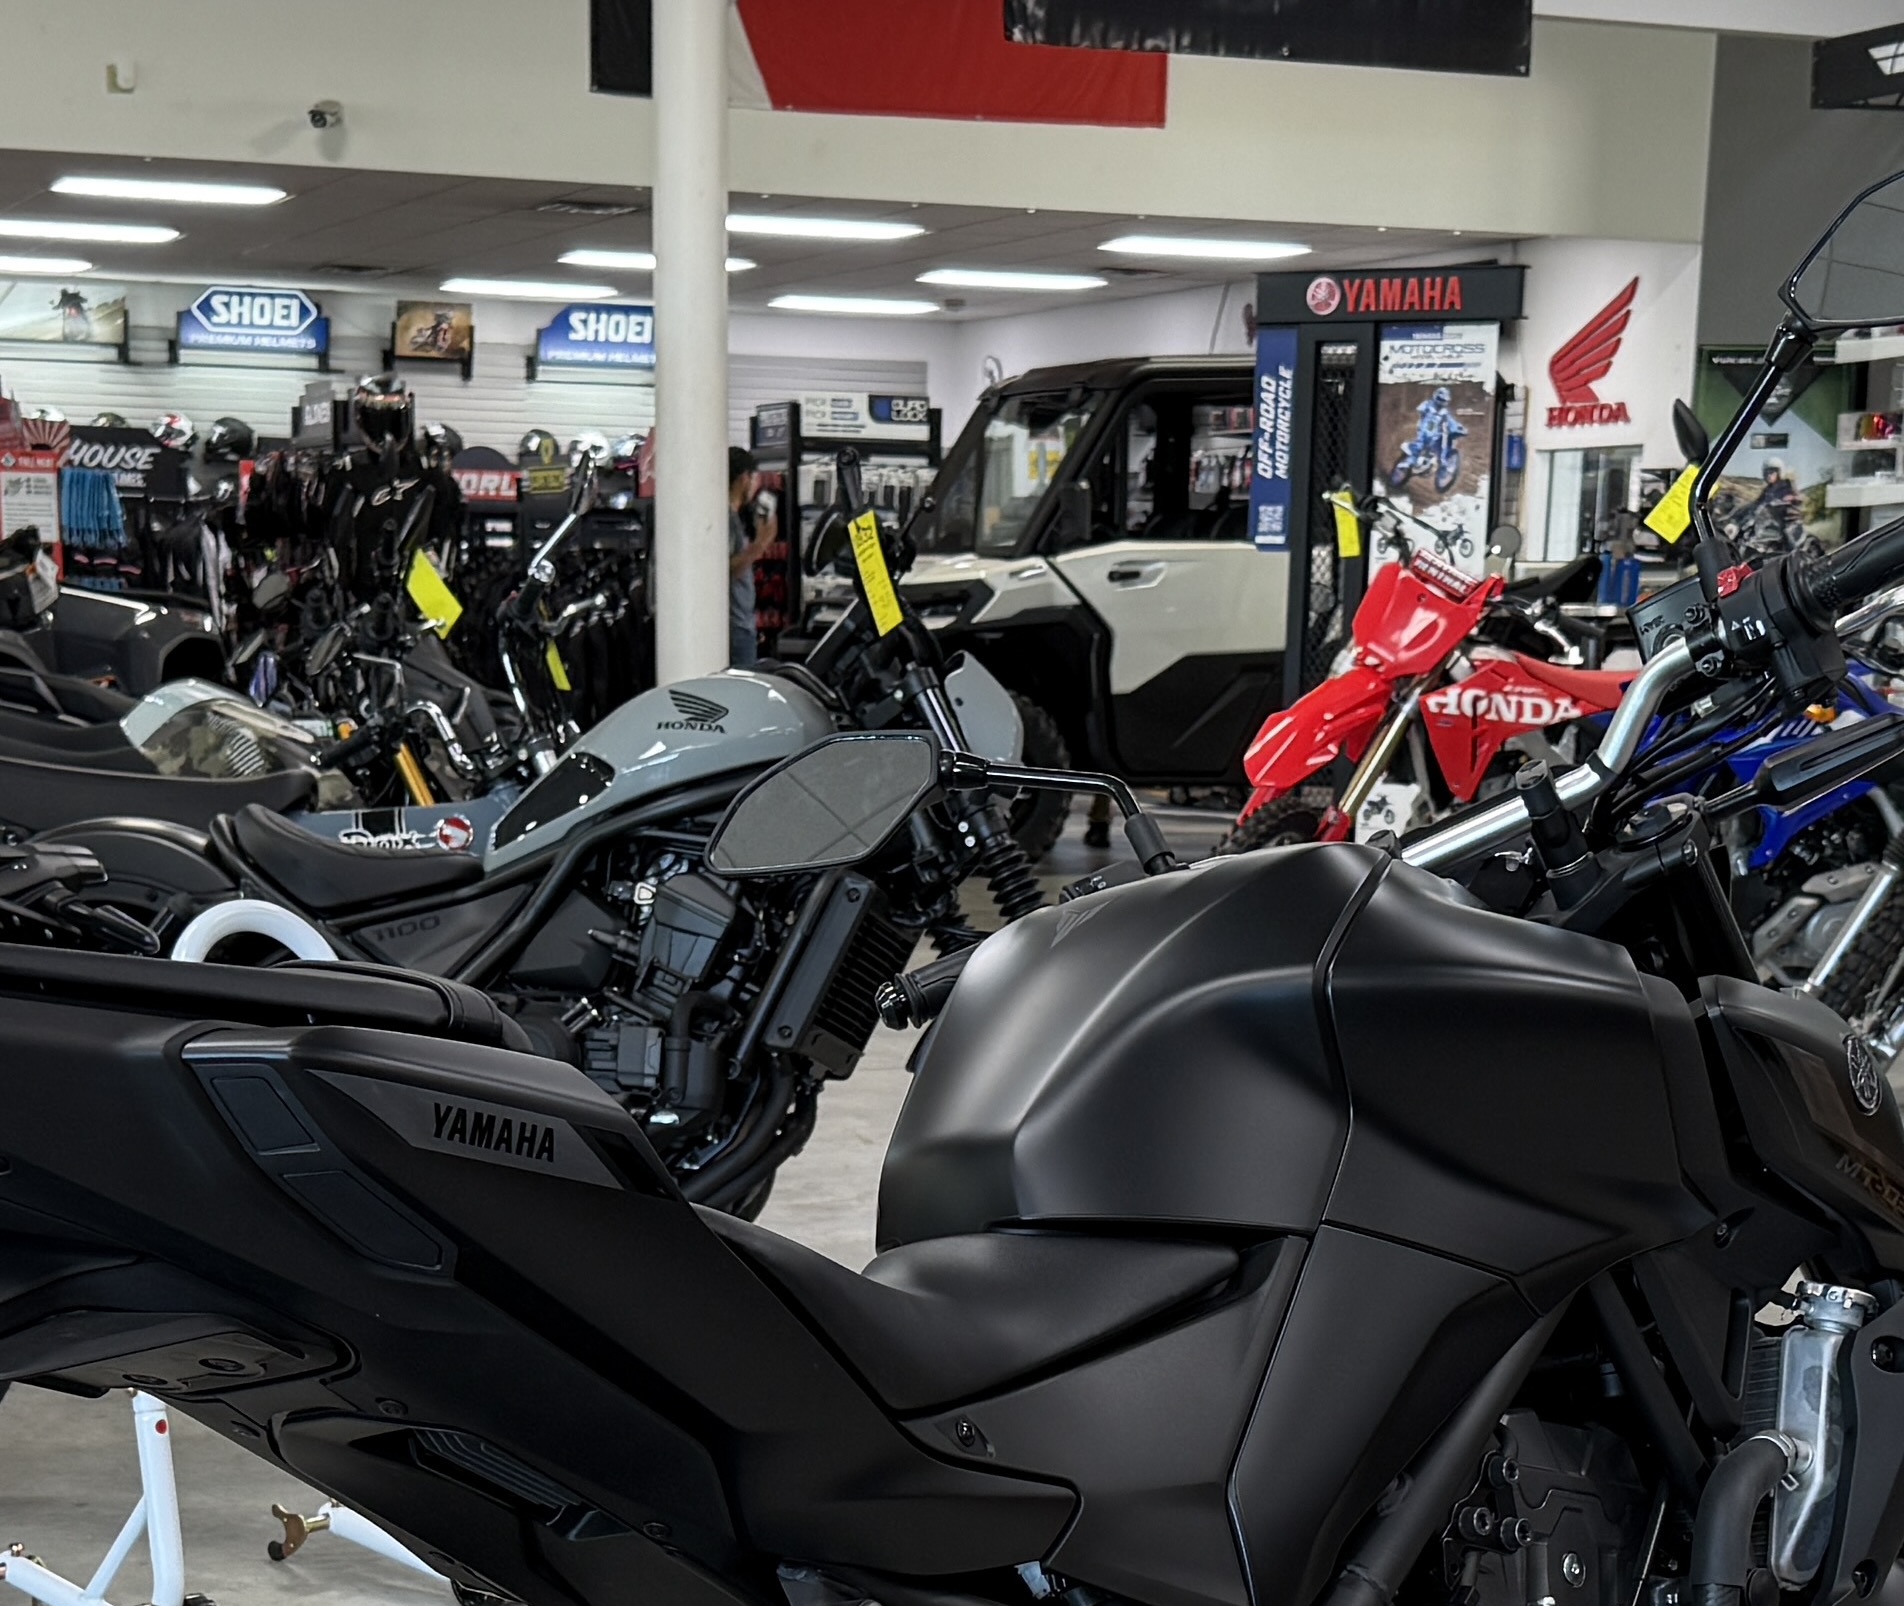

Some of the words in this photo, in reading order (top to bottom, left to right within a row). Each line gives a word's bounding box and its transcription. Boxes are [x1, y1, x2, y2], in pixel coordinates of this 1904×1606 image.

[210, 294, 301, 327] SHOEI
[1343, 276, 1463, 313] YAMAHA
[568, 312, 653, 344] SHOEI
[1257, 375, 1277, 480] OFF-ROAD
[1273, 365, 1294, 480] MOTORCYCLE
[1545, 402, 1631, 428] HONDA
[1425, 687, 1583, 726] HONDA
[655, 717, 727, 734] HONDA
[375, 915, 441, 941] 1100
[430, 1099, 555, 1164] YAMAHA
